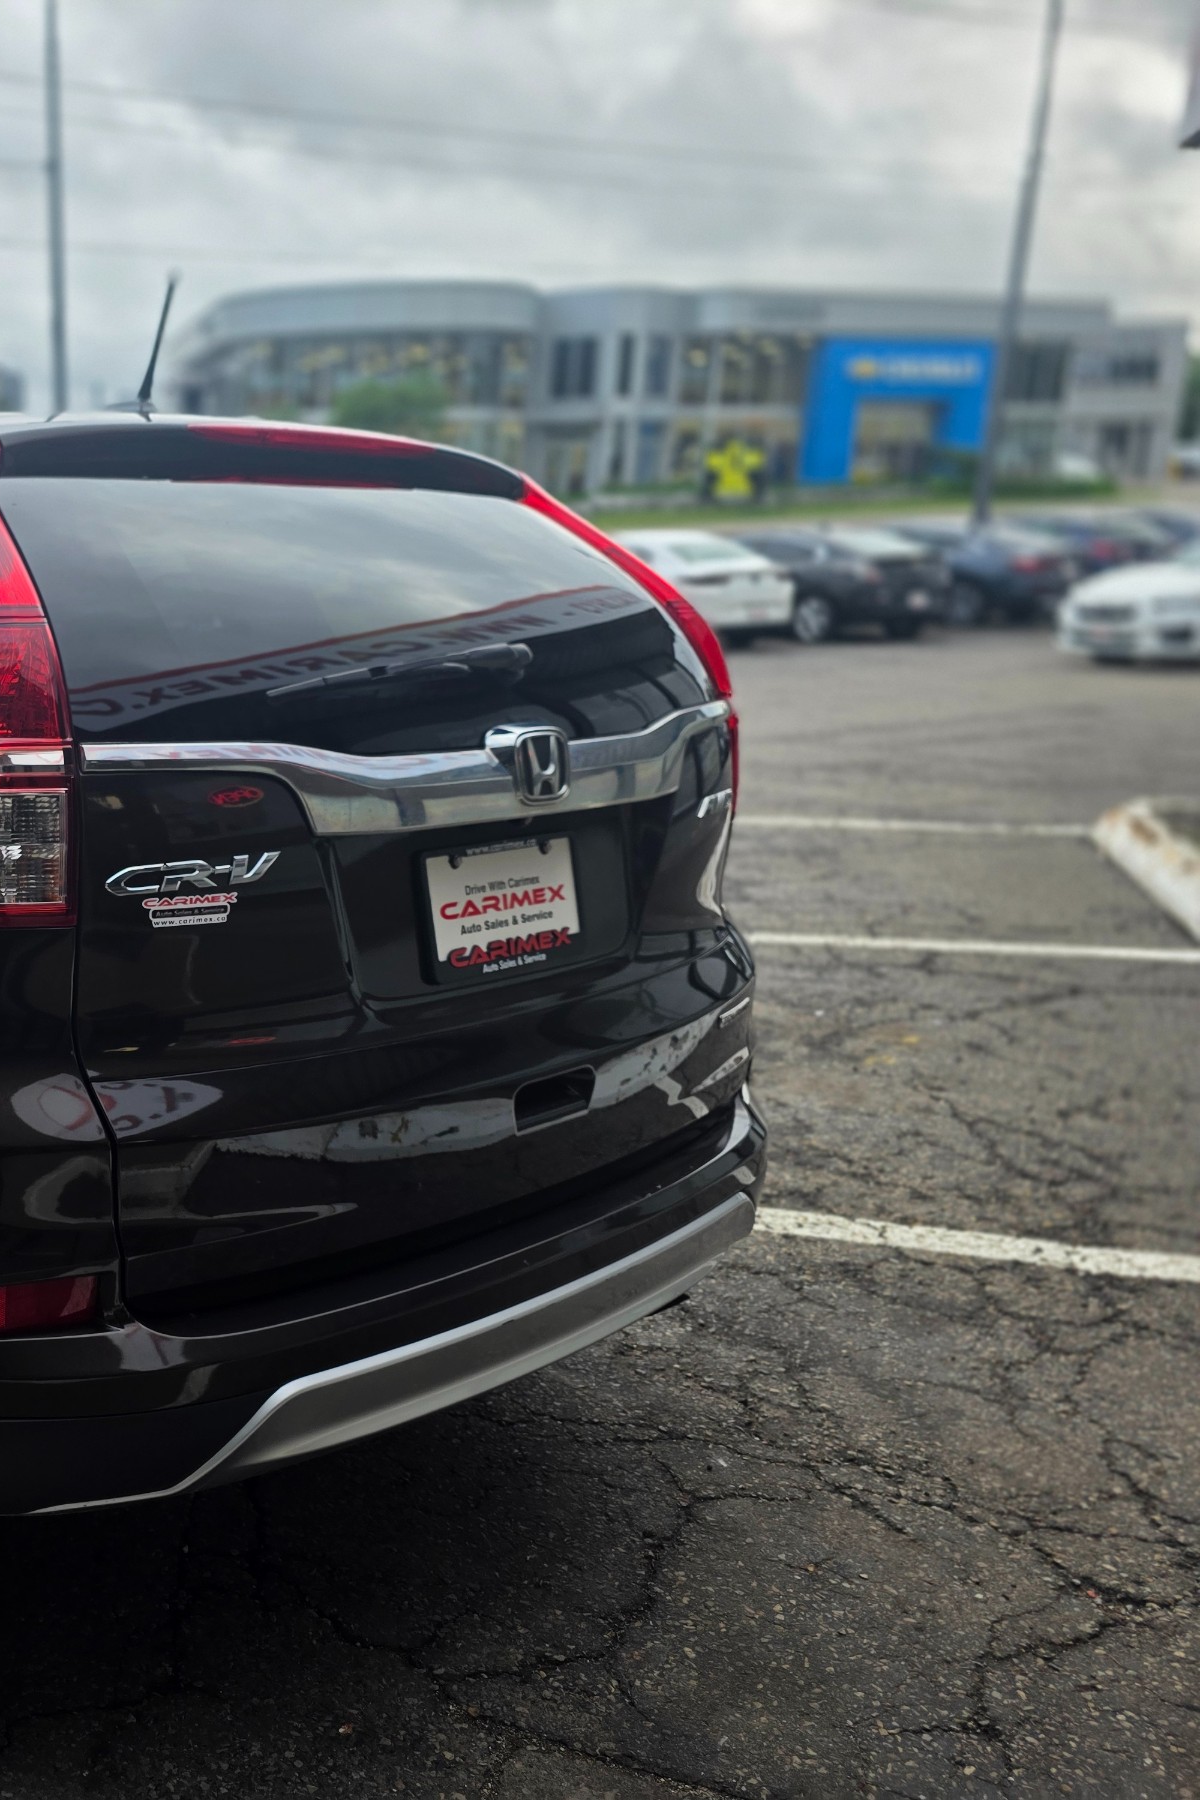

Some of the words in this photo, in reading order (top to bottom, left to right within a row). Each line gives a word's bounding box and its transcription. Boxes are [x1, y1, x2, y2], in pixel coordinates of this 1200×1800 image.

[104, 850, 282, 897] CR-V
[464, 884, 487, 896] Drive
[487, 879, 507, 892] With
[507, 876, 541, 889] Carimex
[142, 893, 237, 908] CARIMEX
[440, 883, 566, 920] CARIMEX
[153, 915, 227, 927] www.carimex.ca
[461, 923, 483, 936] Auto
[484, 918, 510, 932] Sales
[511, 914, 519, 926] &
[521, 909, 554, 924] Service
[449, 927, 572, 968] CARIMEX
[483, 963, 500, 974] Auto
[499, 959, 517, 971] Sales
[517, 956, 524, 966] &
[524, 952, 547, 965] Service
